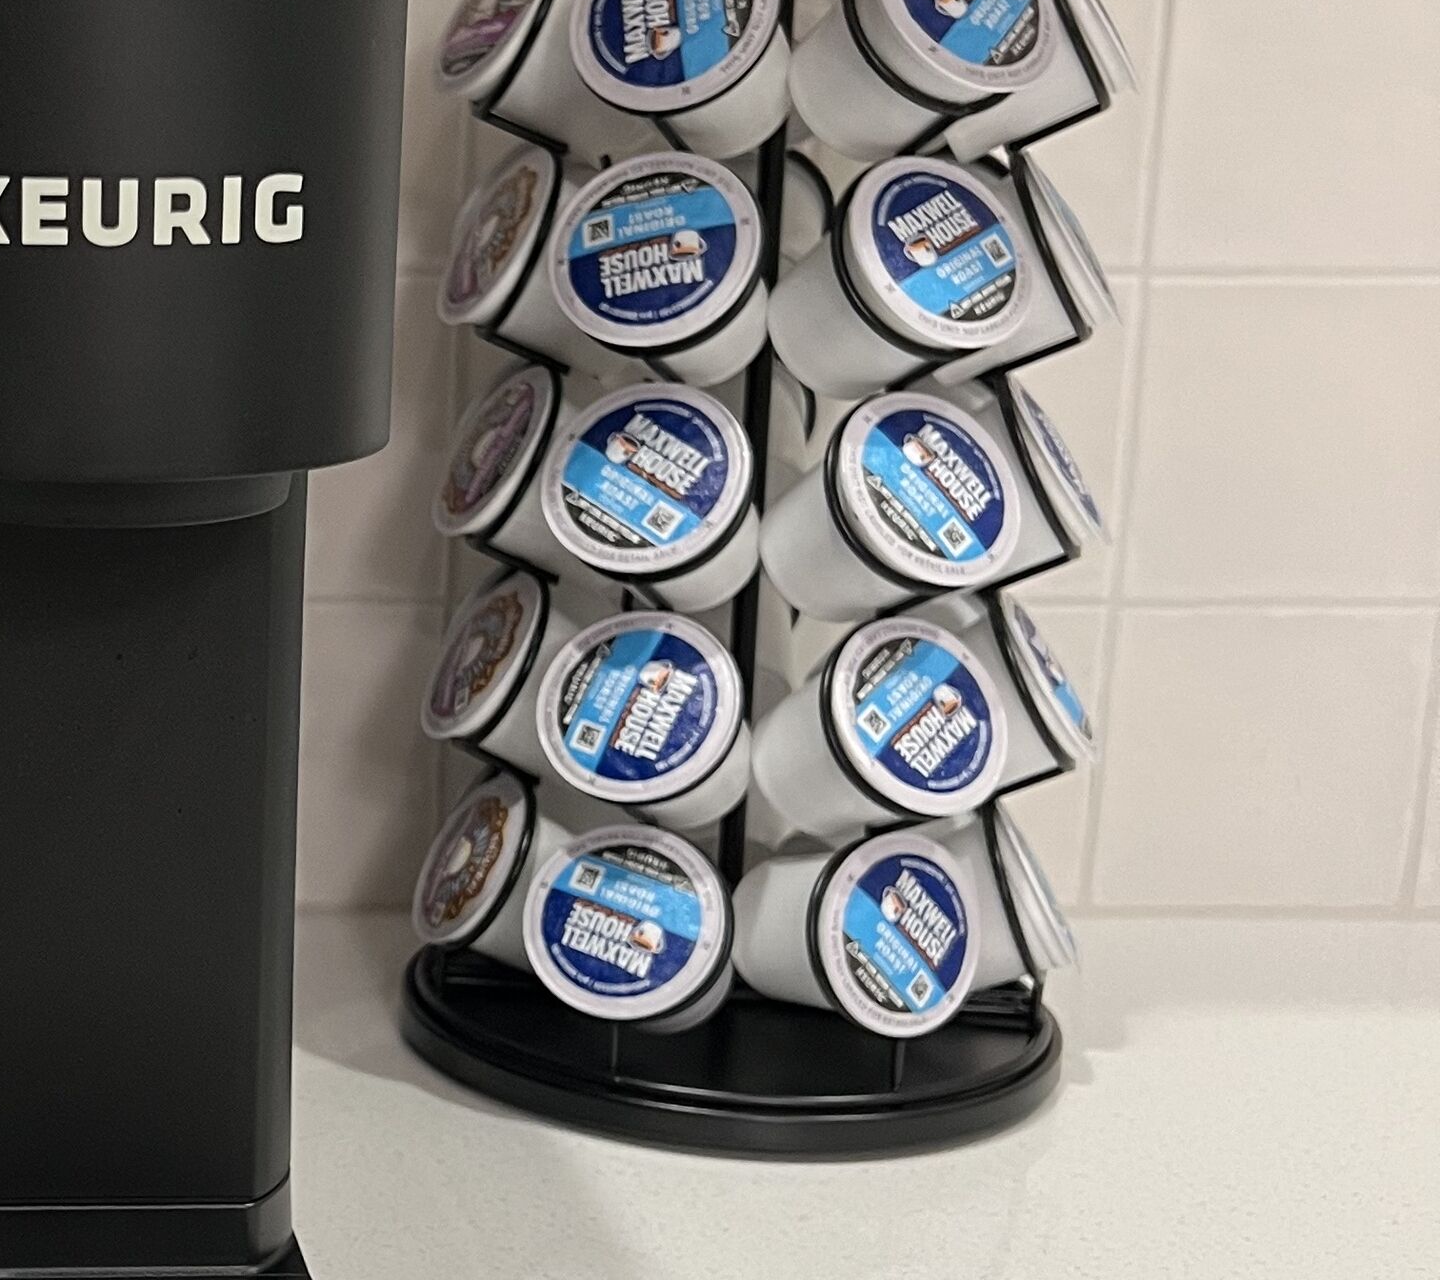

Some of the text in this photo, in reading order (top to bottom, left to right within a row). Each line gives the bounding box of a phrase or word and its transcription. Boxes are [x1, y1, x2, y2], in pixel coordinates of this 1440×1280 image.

[887, 189, 962, 240] MAXWELL
[925, 207, 978, 249] HOUSE
[598, 241, 668, 275] HOUSE
[600, 258, 703, 298] MAXWELL
[623, 412, 710, 477] MAXWELL
[630, 444, 697, 495] HOUSE
[918, 422, 994, 508] MAXWELL
[927, 458, 984, 521] HOUSE
[614, 688, 661, 756] HOUSE
[633, 669, 699, 762] MAXWELL
[892, 705, 947, 762] HOUSE
[908, 706, 978, 778] MAXWELL
[566, 903, 632, 942] HOUSE
[893, 869, 958, 949] MAXWELL
[560, 923, 651, 978] MAXWELL
